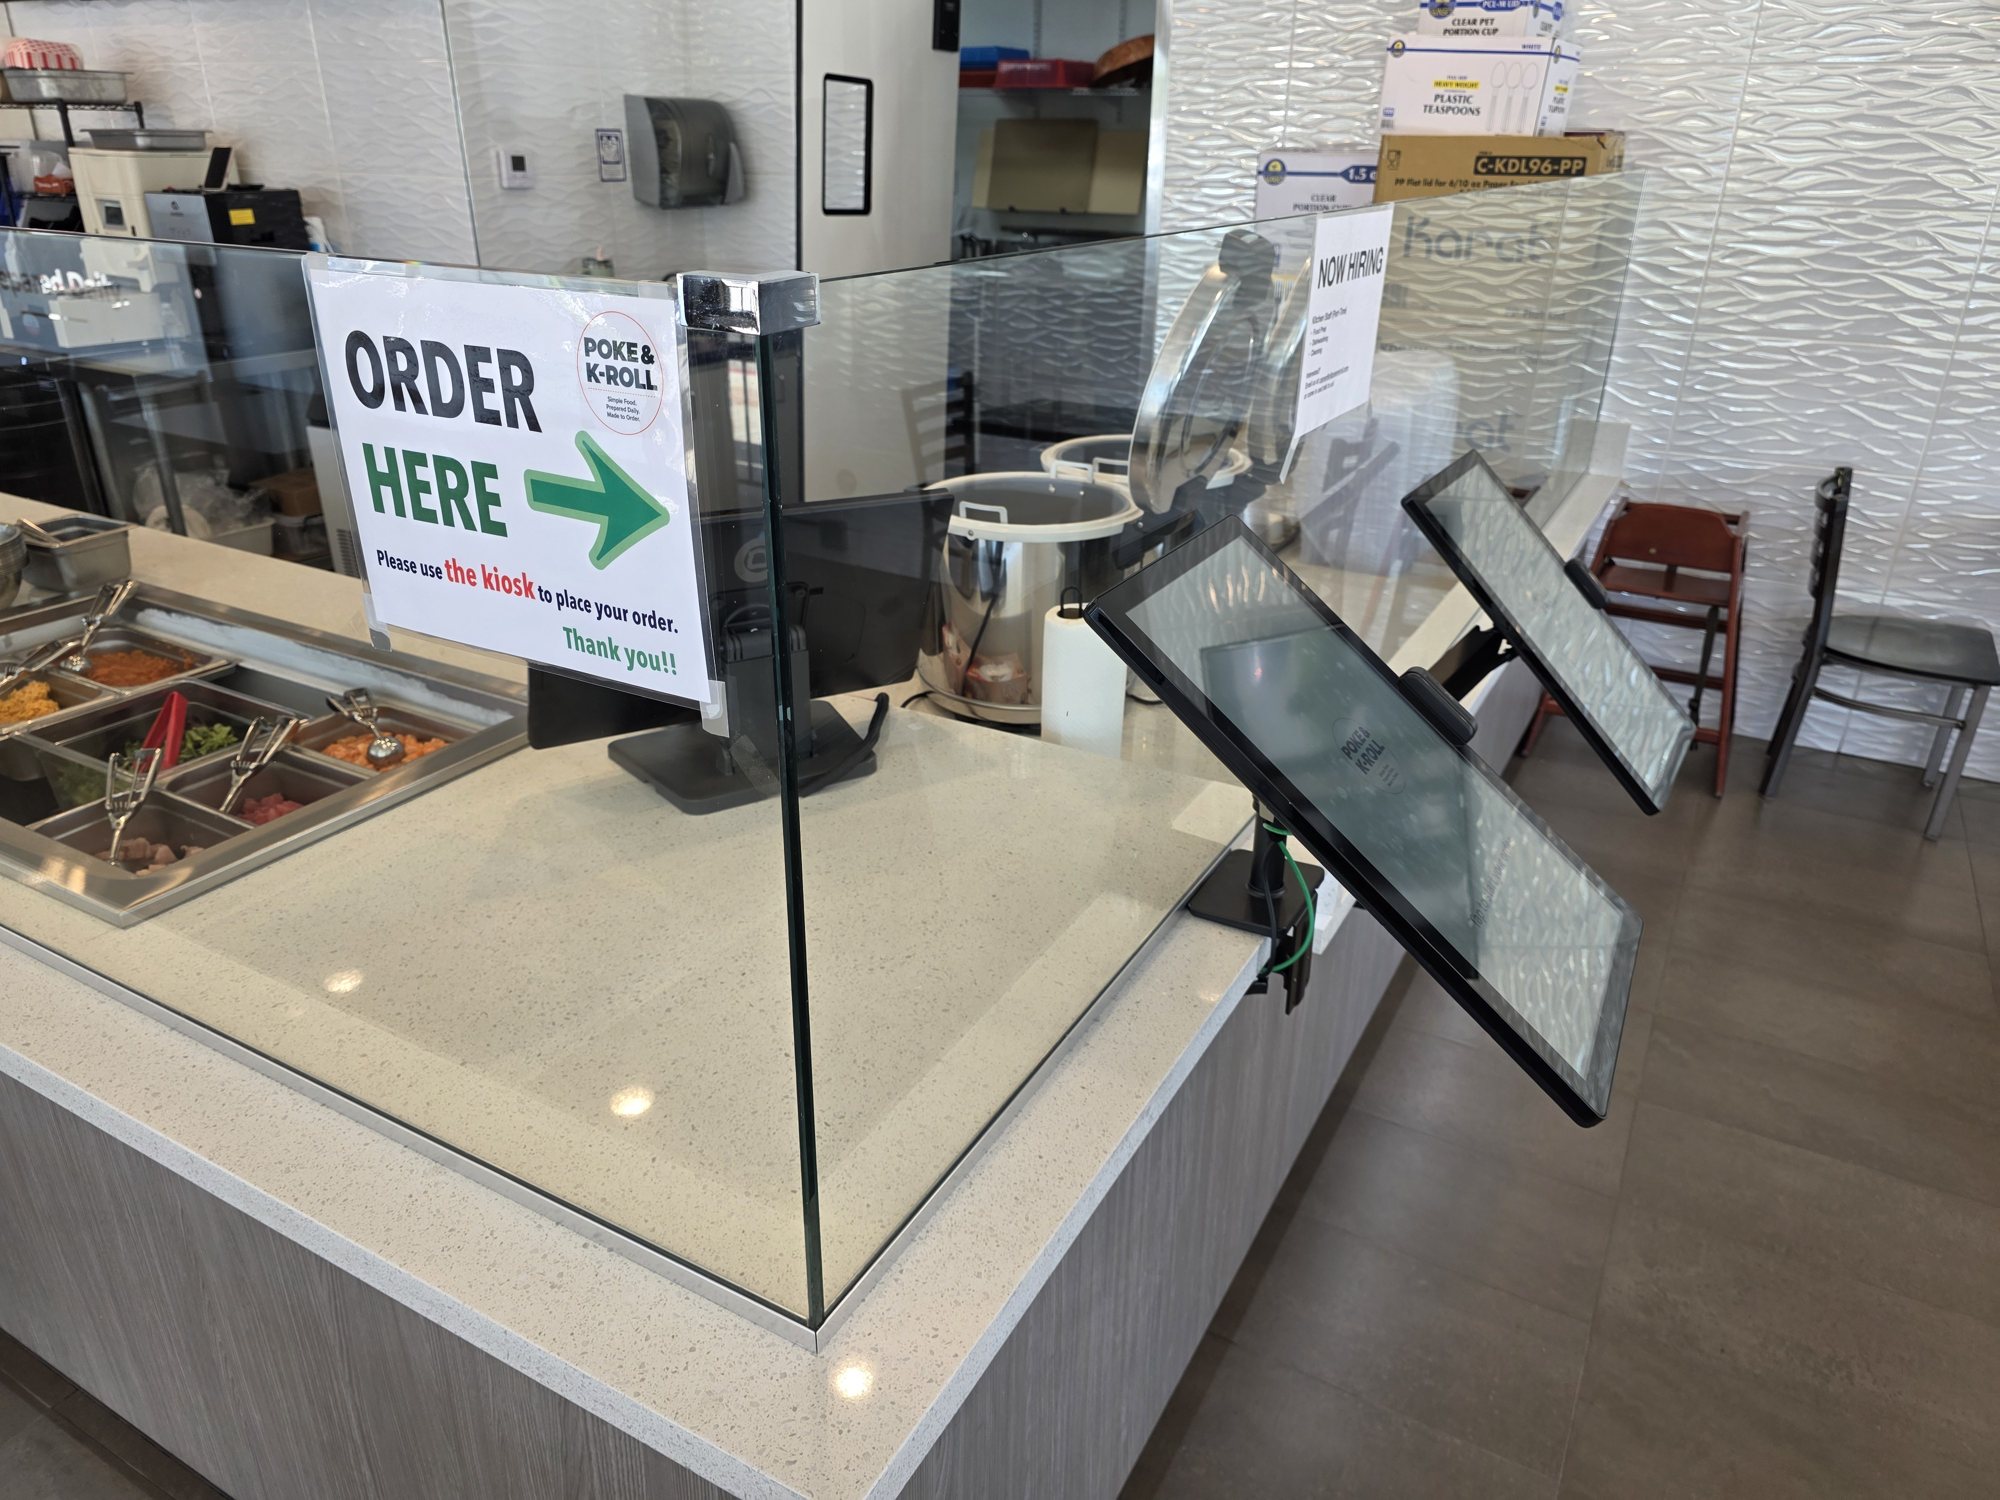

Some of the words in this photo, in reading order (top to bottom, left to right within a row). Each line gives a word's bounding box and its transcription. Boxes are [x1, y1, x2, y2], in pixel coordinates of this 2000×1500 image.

[1451, 18, 1477, 27] CLEAR
[1479, 18, 1495, 26] PET
[1443, 28, 1480, 36] PORTION
[1481, 28, 1499, 36] CUP
[1455, 81, 1479, 89] WEIGHT
[1433, 94, 1473, 104] PLASTIC
[1423, 104, 1481, 116] TEASPOONS
[1476, 158, 1585, 175] C-KDL96-PP
[1349, 168, 1366, 180] 1.5
[1318, 253, 1348, 290] NOW
[1347, 246, 1384, 282] HIRING
[345, 329, 543, 434] ORDER
[585, 362, 658, 391] K-ROLL
[607, 396, 623, 404] Simple
[606, 404, 627, 412] Prepared
[362, 442, 508, 538] HERE
[376, 549, 418, 575] Please
[420, 561, 443, 581] use
[445, 559, 477, 588] the
[481, 564, 536, 600] kiosk
[538, 585, 553, 604] to
[556, 590, 591, 615] place
[595, 601, 628, 623] your
[633, 608, 679, 634] order.
[562, 626, 621, 662] Thank
[624, 648, 678, 676] you!!
[1355, 739, 1385, 775] K-ROLL
